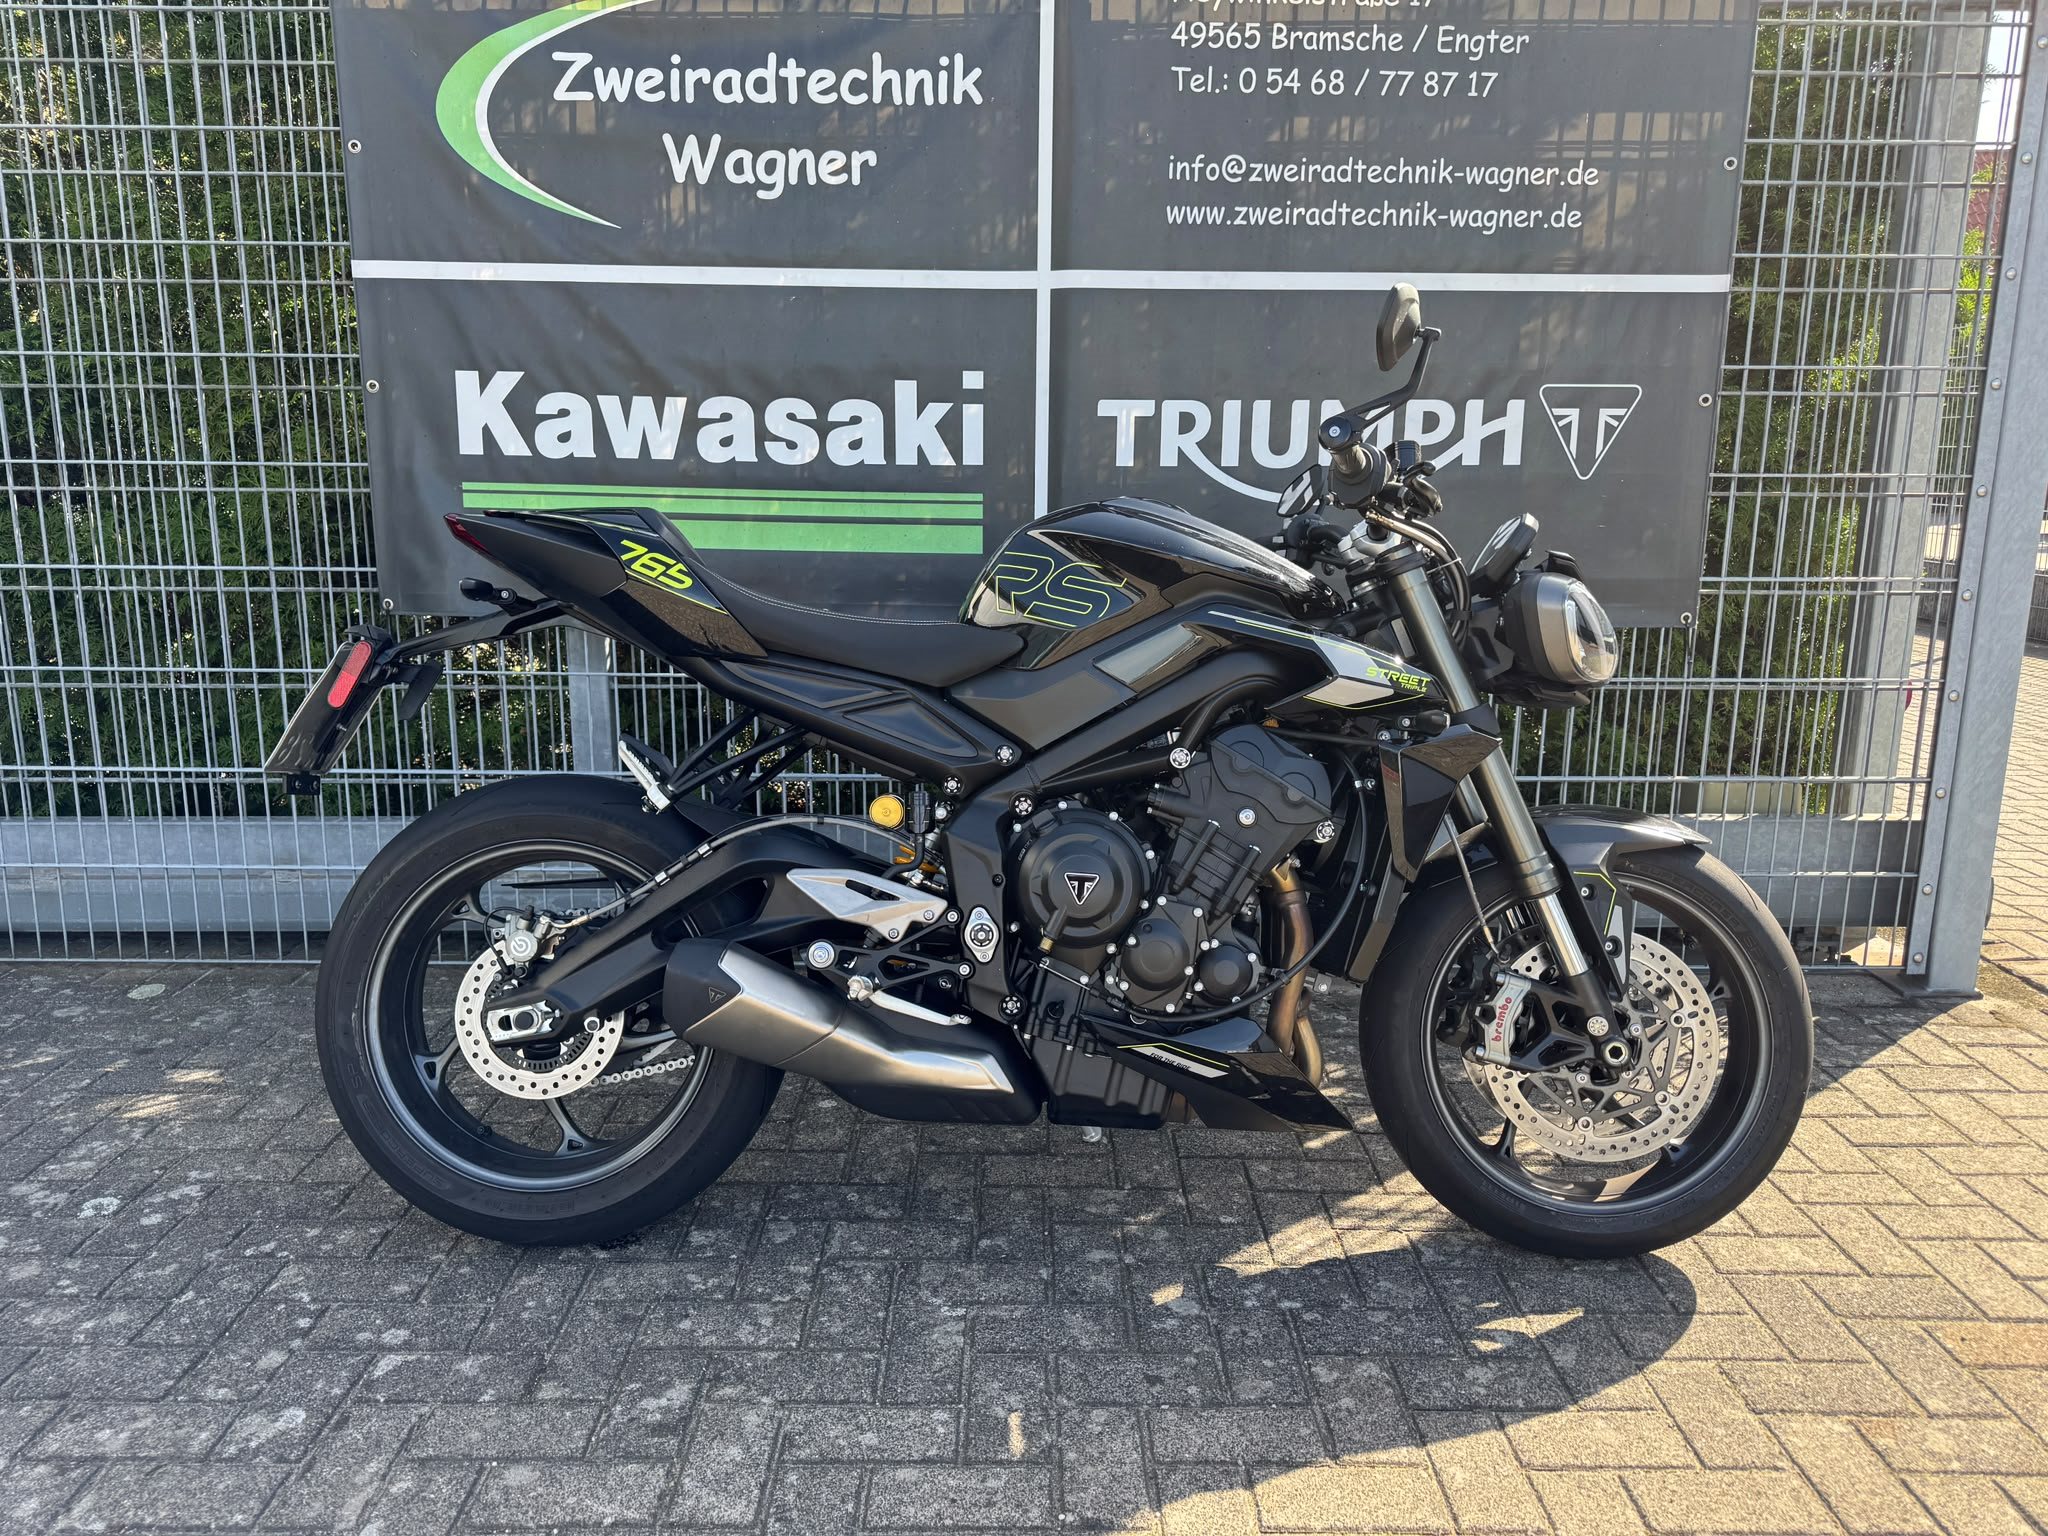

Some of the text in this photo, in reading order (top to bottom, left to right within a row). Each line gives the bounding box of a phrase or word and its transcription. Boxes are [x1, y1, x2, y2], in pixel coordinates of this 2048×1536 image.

[1170, 20, 1531, 61] 49565 Bramsche / Engter
[551, 51, 984, 106] Zweiradtechnik
[1170, 66, 1500, 98] Tel.: 0 54 68 / 77 87 17
[662, 132, 878, 200] Wagner
[1168, 154, 1600, 193] info@zweiradtechnik-wagner.de
[1165, 199, 1583, 235] www.zweiradtechnik-wagner.de
[454, 370, 985, 466] Kawasaki
[1097, 399, 1526, 503] TRIUMPH
[619, 539, 694, 590] 765
[1366, 667, 1430, 687] STREET
[1401, 683, 1427, 692] TRIPLE
[1491, 996, 1512, 1042] brembo
